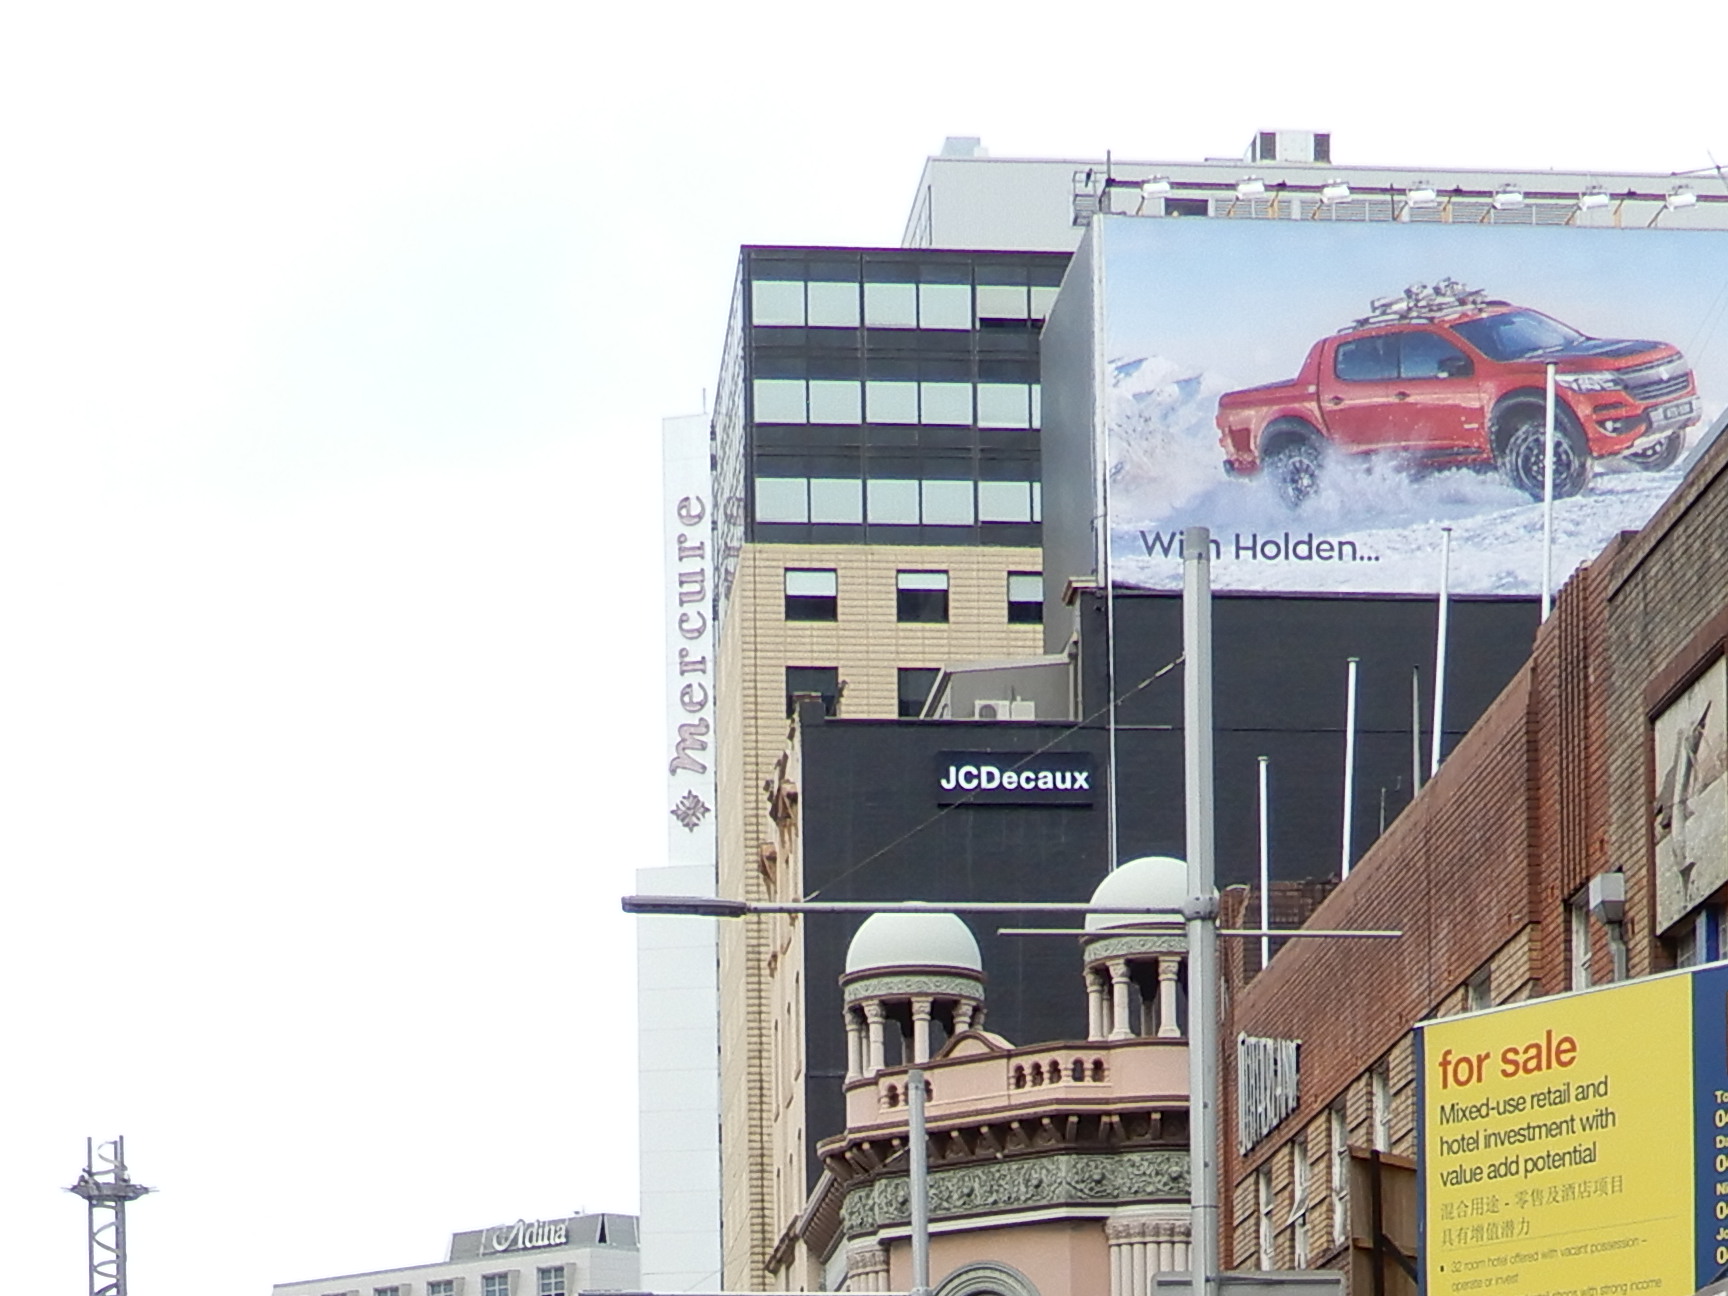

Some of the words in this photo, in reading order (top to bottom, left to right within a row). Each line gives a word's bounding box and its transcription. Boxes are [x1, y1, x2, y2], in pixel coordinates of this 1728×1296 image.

[1139, 530, 1221, 560] Wi
[1234, 532, 1380, 561] Holden...
[669, 495, 710, 777] mercure
[940, 762, 1090, 791] JCDecaux
[1439, 1049, 1490, 1090] for
[1500, 1029, 1578, 1080] sale
[1439, 1093, 1527, 1126] Mixed-use
[1530, 1083, 1571, 1110] retail
[1575, 1076, 1609, 1102] and
[1439, 1130, 1480, 1156] hotel
[1482, 1116, 1576, 1151] investment
[1580, 1108, 1616, 1133] with
[1440, 1163, 1485, 1188] value
[1488, 1155, 1520, 1179] add
[1523, 1141, 1597, 1177] potential
[492, 1219, 567, 1252] Adina
[1487, 1255, 1509, 1269] hotel
[1509, 1251, 1539, 1266] offered
[1560, 1244, 1589, 1258] vacant
[1590, 1237, 1639, 1256] possession
[1451, 1278, 1483, 1293] operate
[1495, 1273, 1520, 1286] invest
[1629, 1276, 1663, 1292] income
